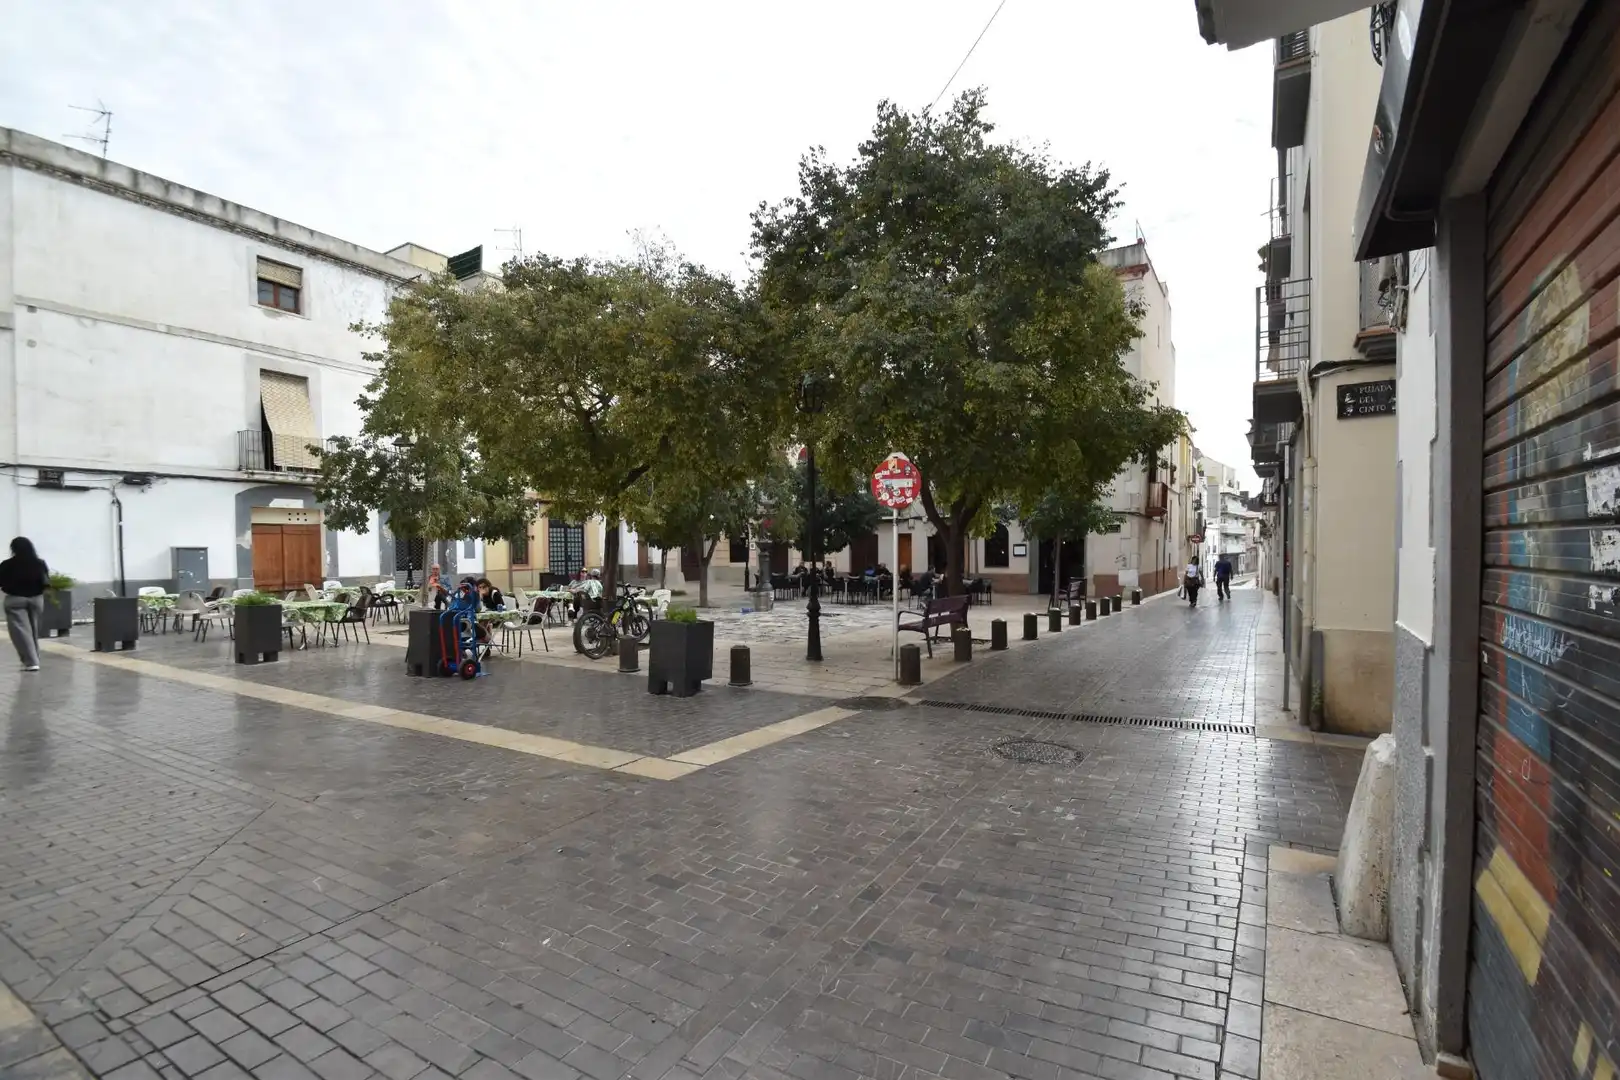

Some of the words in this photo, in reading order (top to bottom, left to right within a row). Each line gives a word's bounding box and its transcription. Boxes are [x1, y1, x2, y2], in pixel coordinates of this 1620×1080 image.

[1359, 384, 1393, 394] PUJADA
[1359, 395, 1376, 404] DEL
[1359, 404, 1387, 413] CINTO
